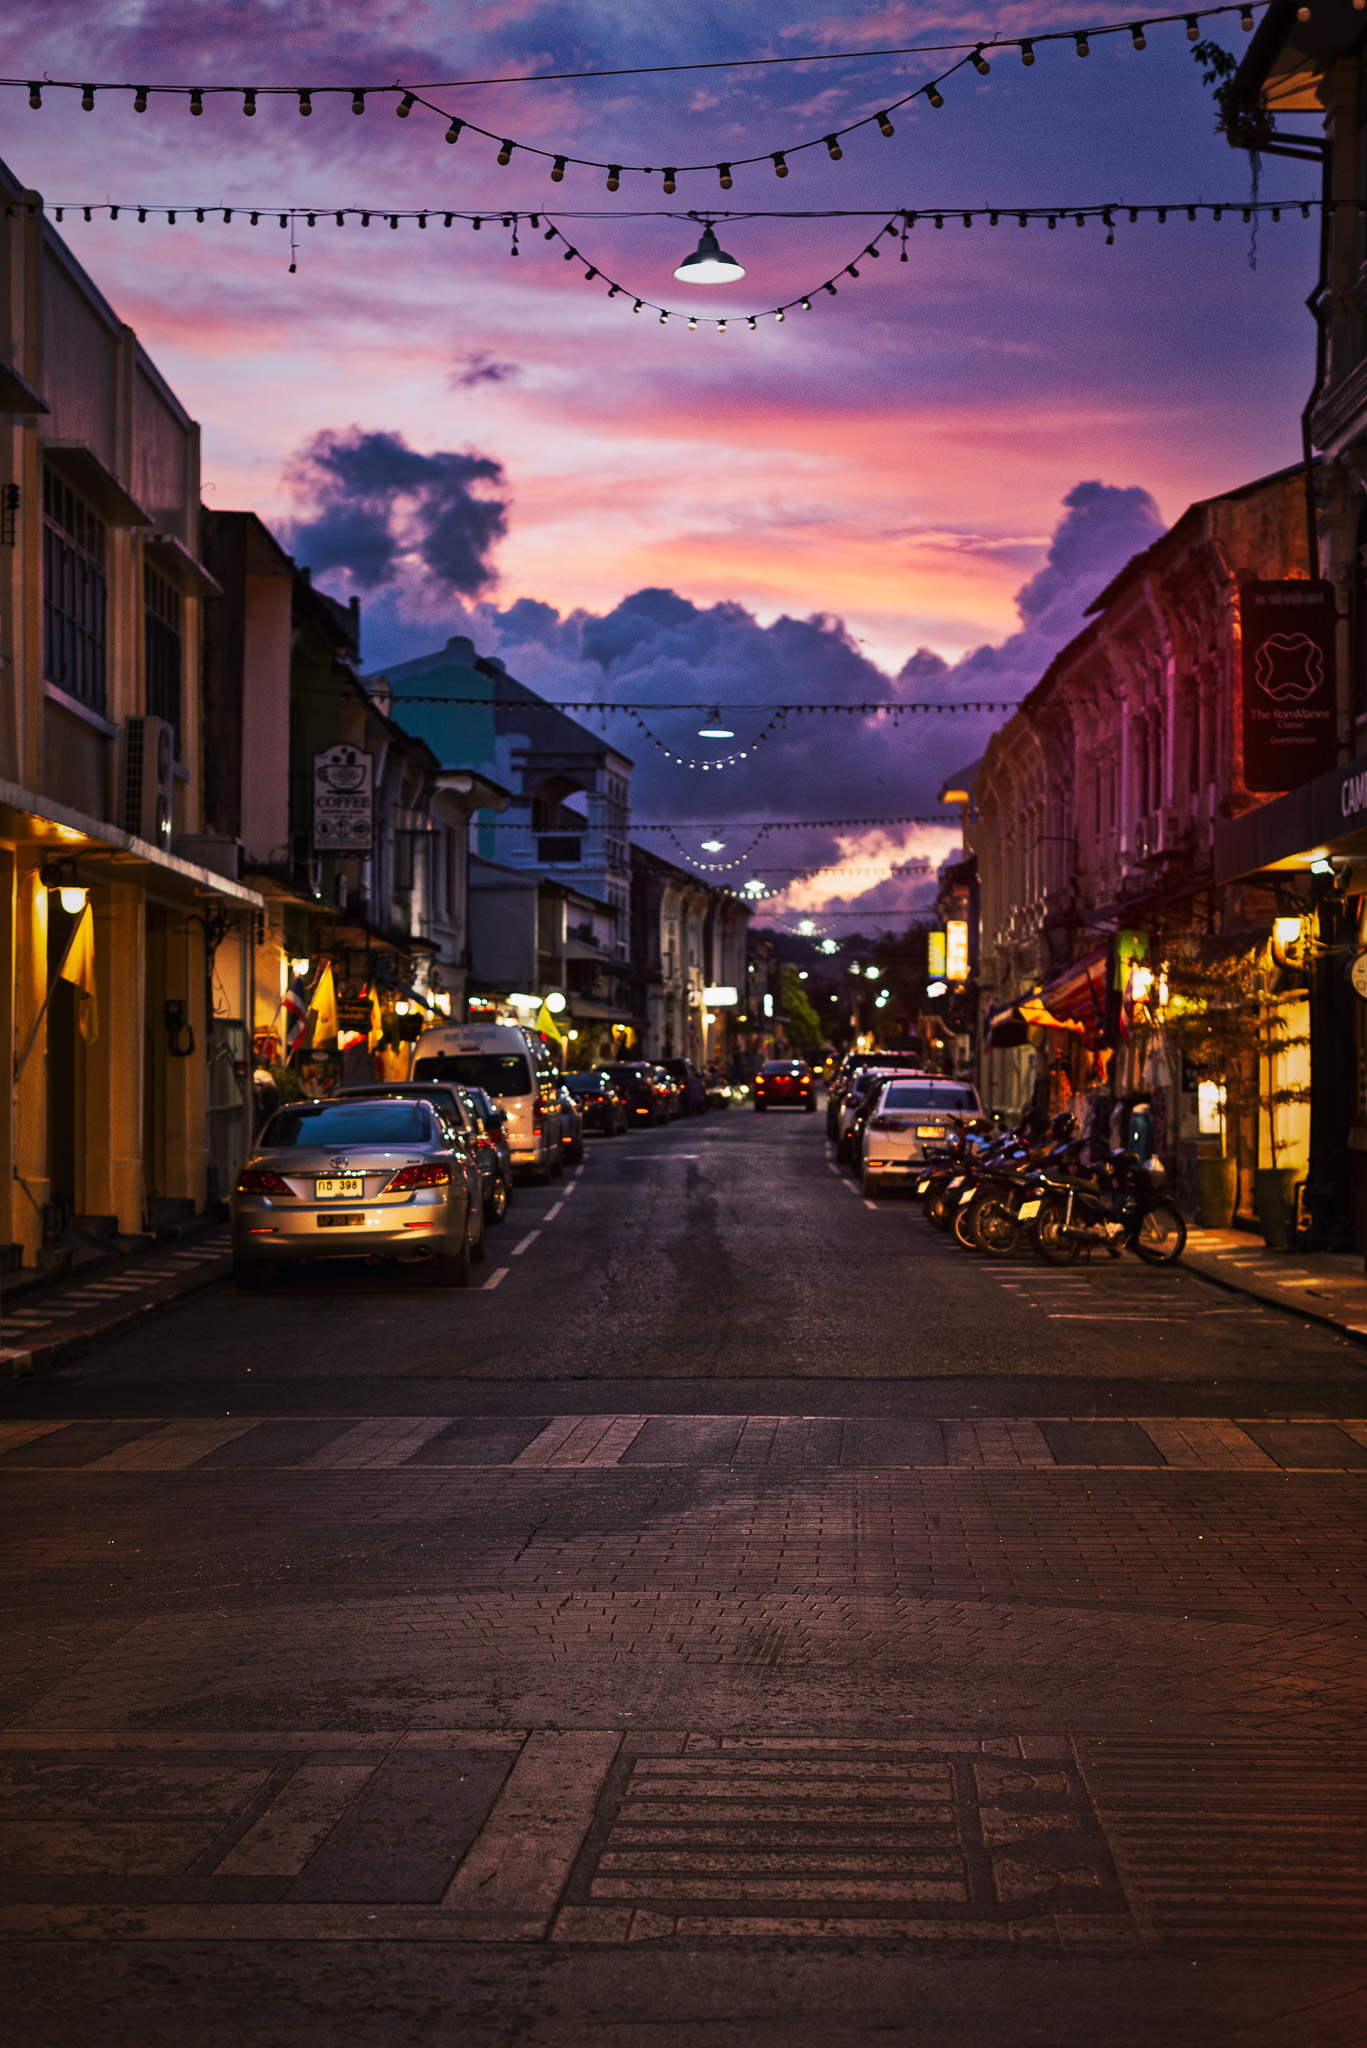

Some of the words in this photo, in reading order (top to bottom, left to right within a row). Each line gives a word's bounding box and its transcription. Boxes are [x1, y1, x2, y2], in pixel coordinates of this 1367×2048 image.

[1251, 709, 1271, 719] The
[1341, 770, 1367, 817] CAM
[317, 797, 370, 808] COFFEE
[340, 1181, 357, 1189] 398
